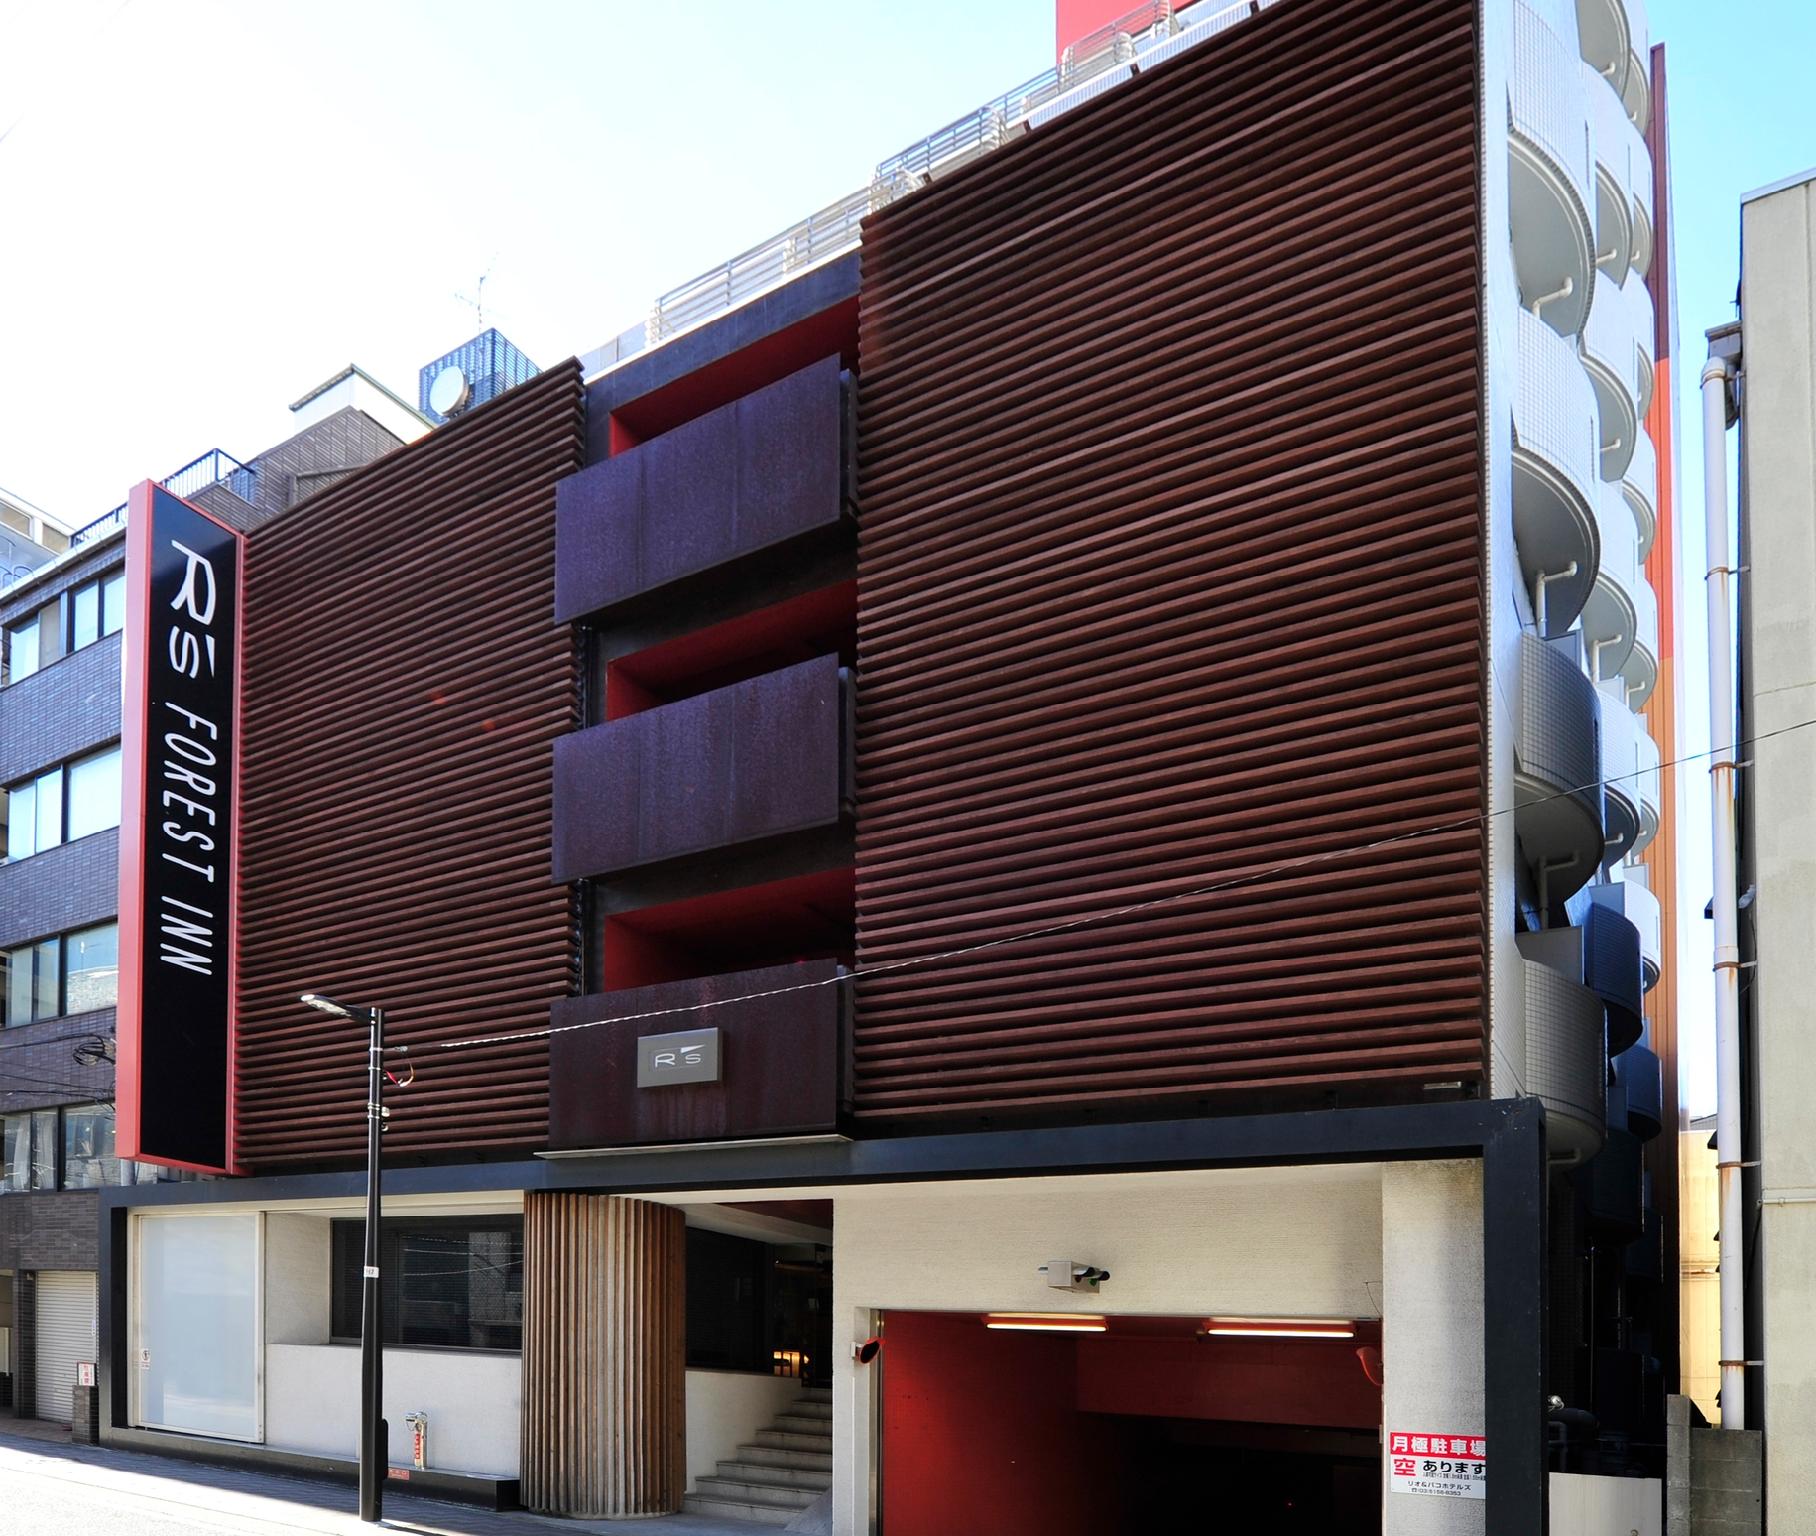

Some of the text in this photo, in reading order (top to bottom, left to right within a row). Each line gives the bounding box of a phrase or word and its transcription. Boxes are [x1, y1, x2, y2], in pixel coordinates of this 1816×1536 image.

[162, 702, 217, 883] FOREST
[160, 895, 214, 975] INN
[1392, 1436, 1486, 1456] 月極駐車場
[1423, 1460, 1486, 1475] あります
